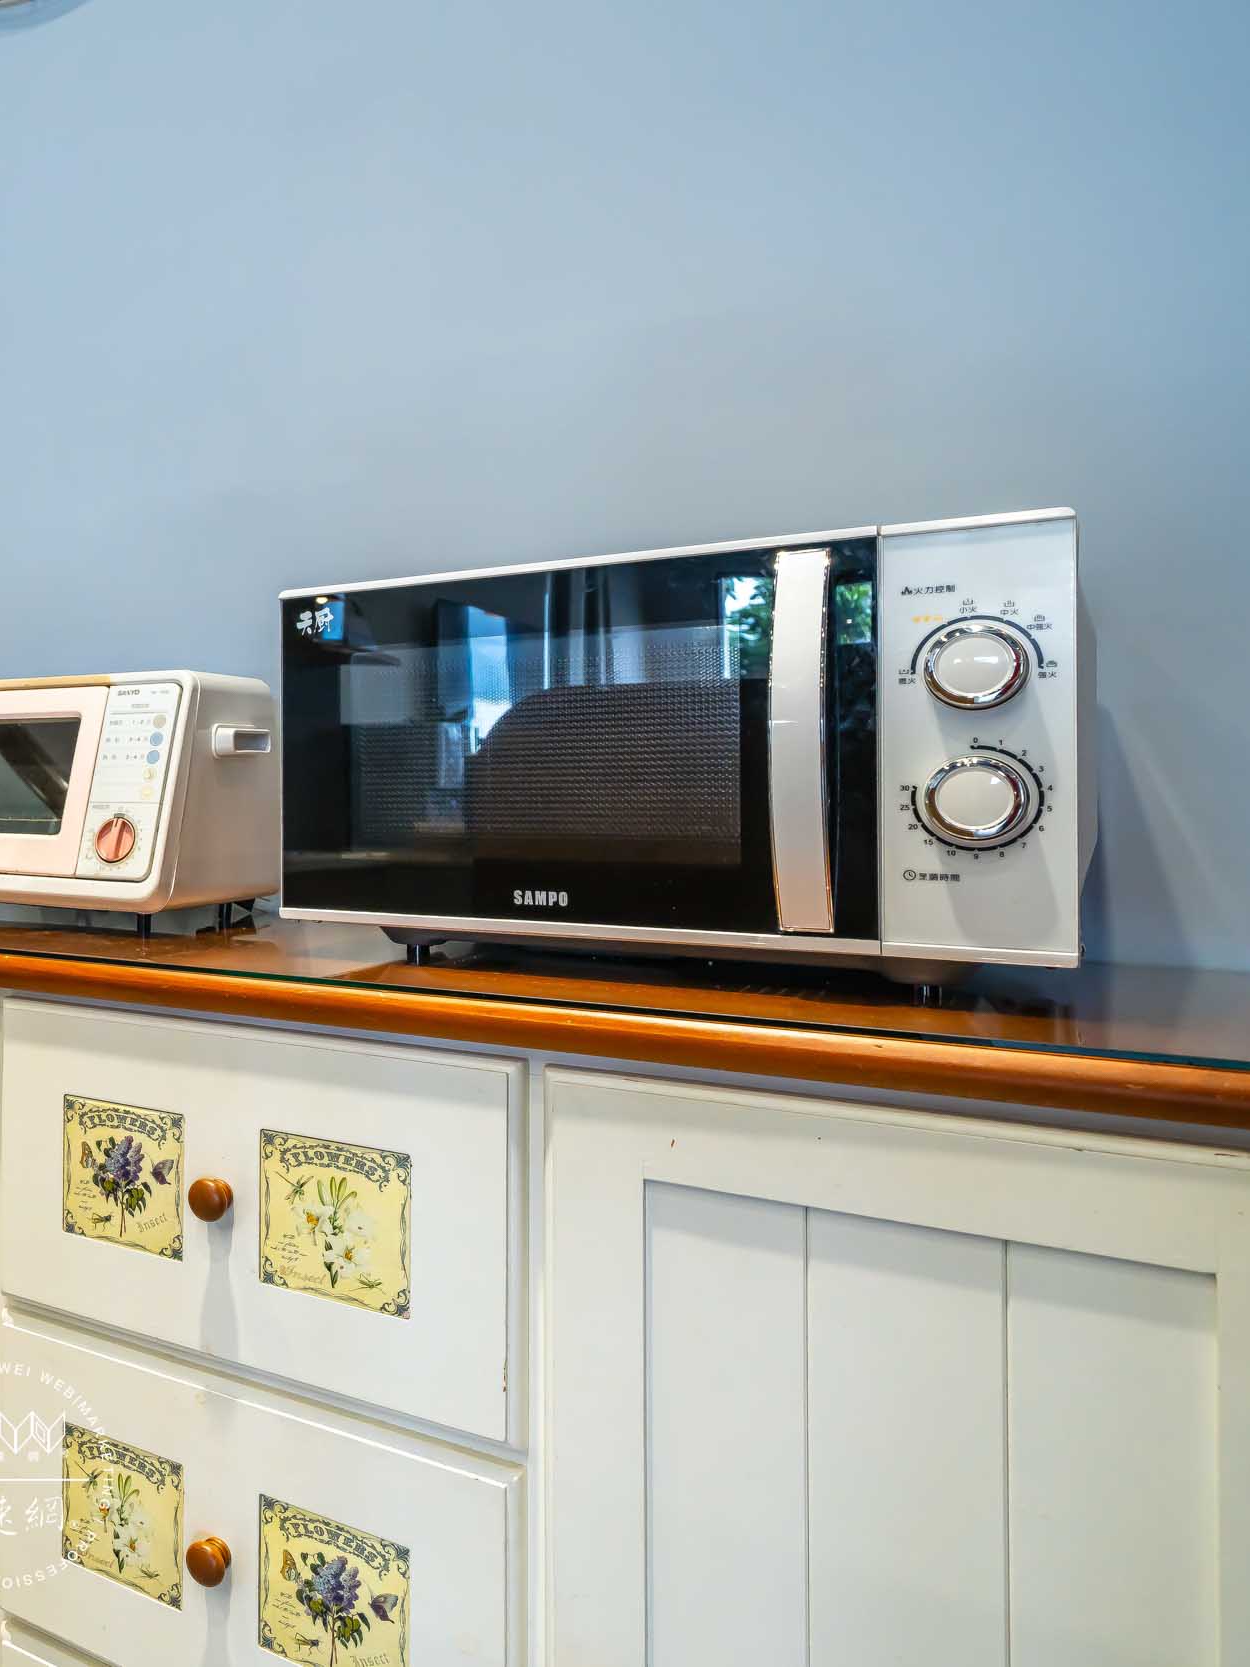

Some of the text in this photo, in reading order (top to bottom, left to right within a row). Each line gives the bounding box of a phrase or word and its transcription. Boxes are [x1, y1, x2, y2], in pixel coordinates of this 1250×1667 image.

[913, 584, 956, 596] 火力控制
[959, 606, 977, 614] 小火
[1000, 608, 1019, 616] 中火
[900, 784, 910, 792] 30
[908, 823, 918, 831] 20
[513, 889, 568, 907] SAMPO
[86, 1112, 158, 1137] FLOWERS
[288, 1150, 378, 1177] FLOWERS
[289, 1521, 379, 1563] FLOWERS
